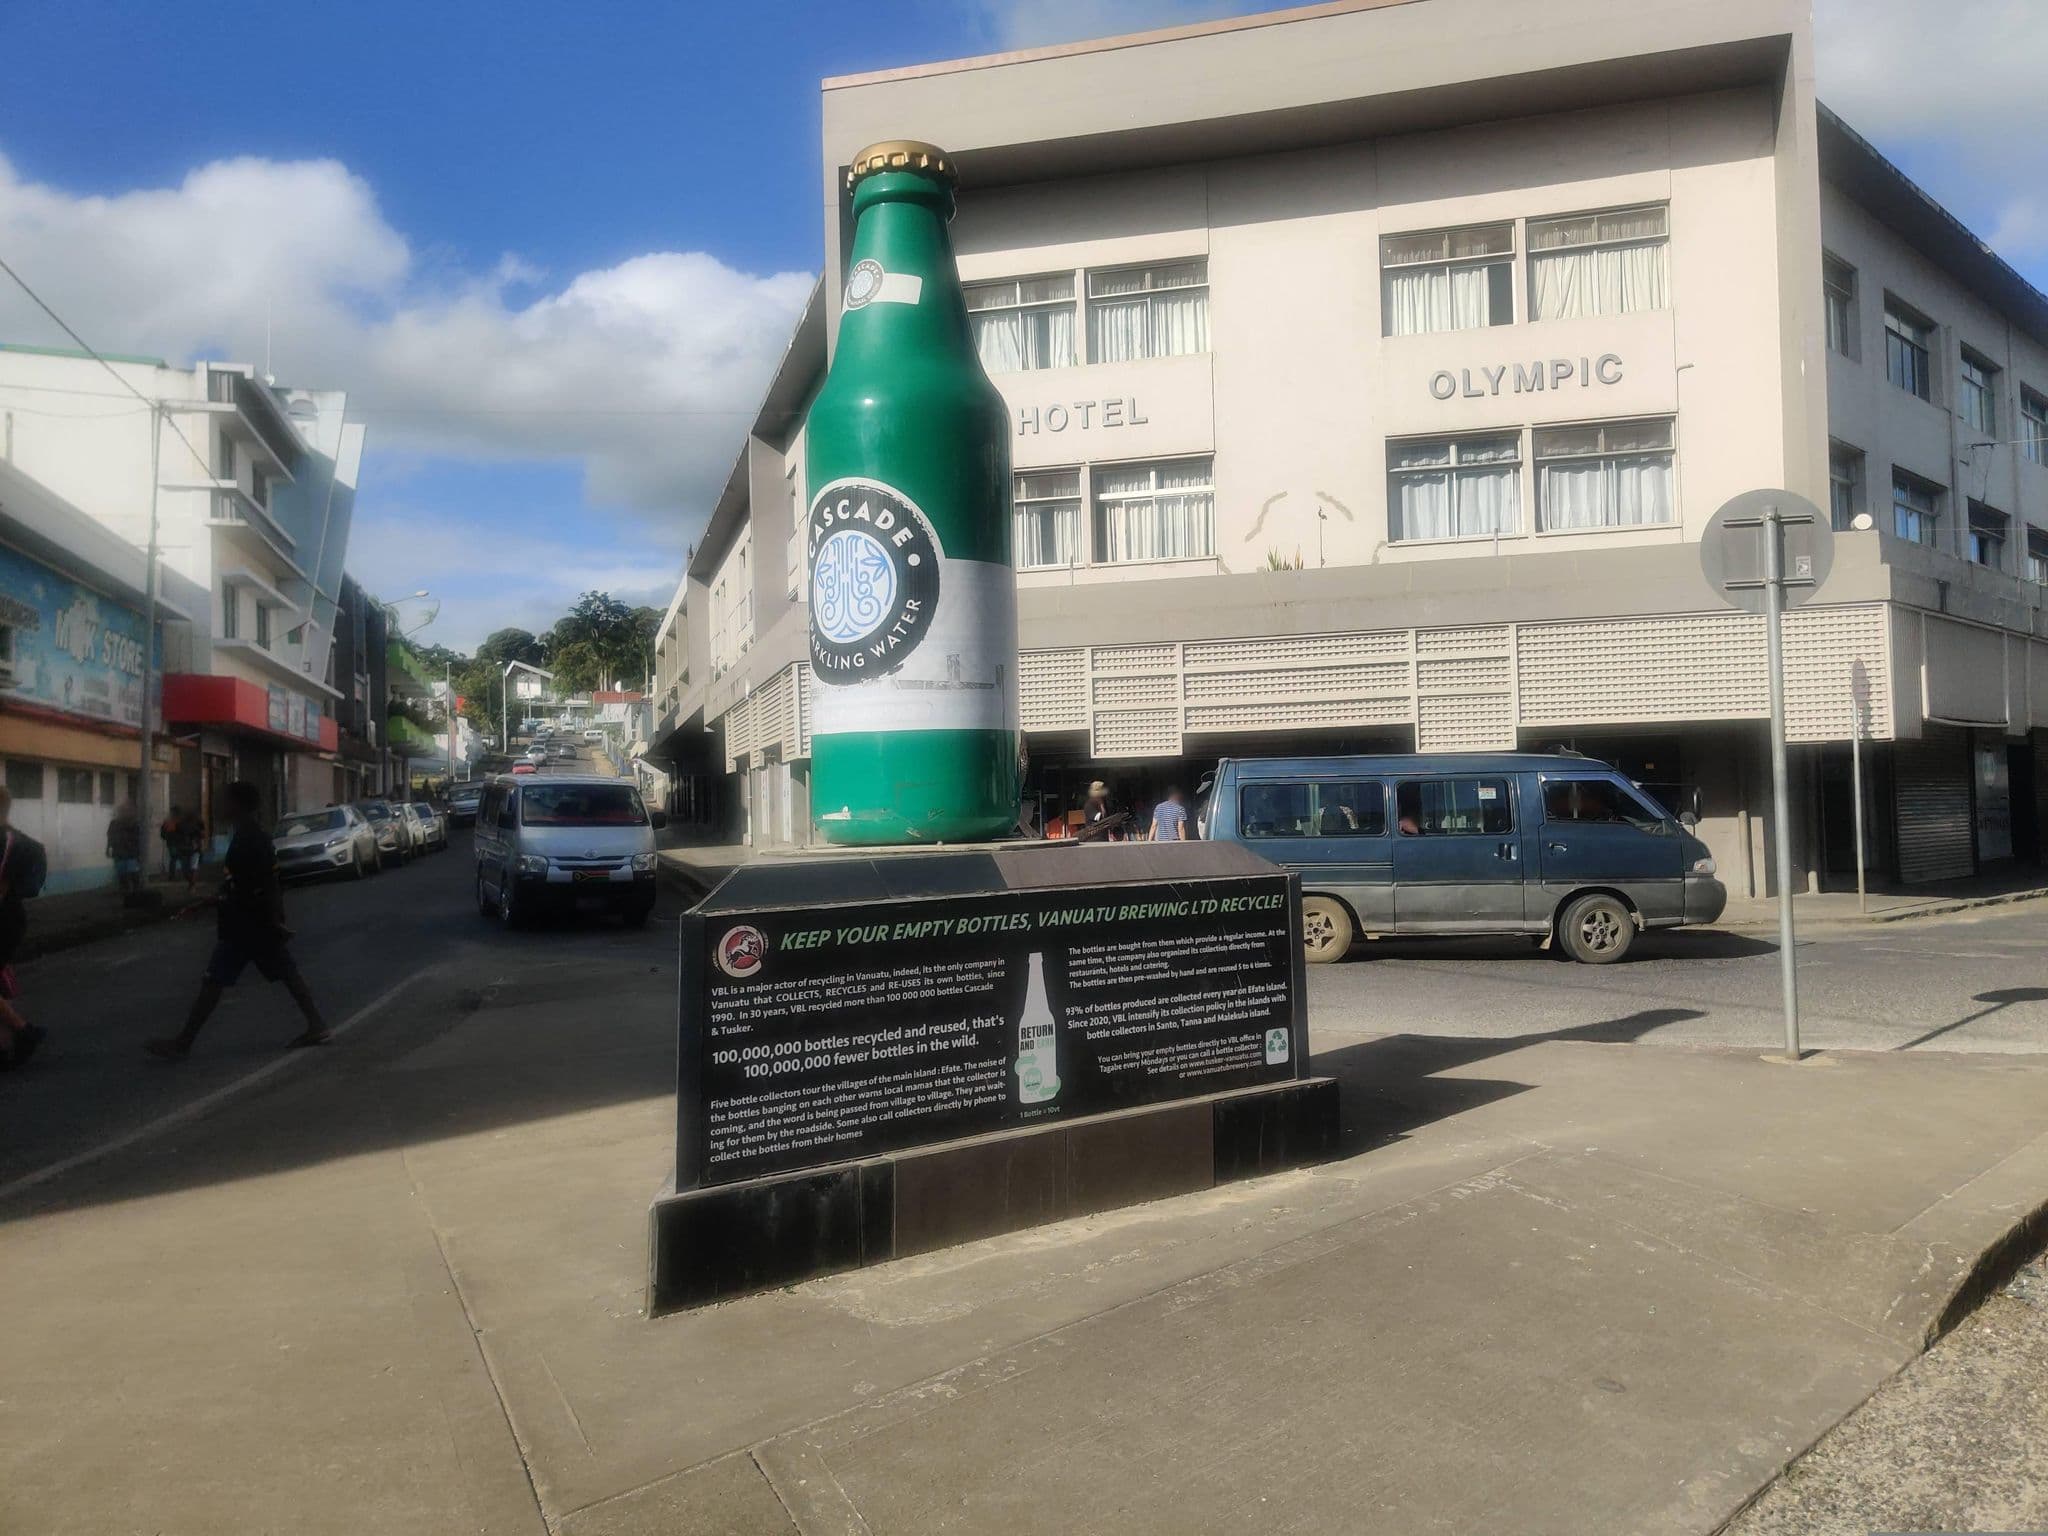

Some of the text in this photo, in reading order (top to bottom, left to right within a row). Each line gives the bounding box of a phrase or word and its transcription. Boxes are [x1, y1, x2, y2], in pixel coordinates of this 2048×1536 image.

[1018, 353, 1625, 435] HOTEL OLYMPIC
[870, 598, 922, 660] WATER
[781, 930, 831, 950] KEEP
[837, 925, 888, 945] YOUR
[892, 919, 954, 940] EMPTY
[956, 913, 1032, 934] BOTTLES,
[1039, 906, 1116, 927] VANUATU
[1118, 901, 1189, 920] BREWING
[1192, 899, 1218, 914] LTD
[1220, 894, 1284, 912] RECYCLE!
[712, 987, 729, 996] VBL
[730, 985, 737, 994] is
[746, 982, 773, 993] major
[774, 981, 796, 989] actor
[798, 978, 807, 987] of
[808, 975, 845, 986] recycling
[846, 973, 854, 981] in
[856, 971, 891, 980] Vanuatu,
[893, 966, 921, 976] indeed,
[923, 965, 932, 973] its
[933, 964, 946, 972] the
[947, 962, 963, 971] only
[964, 960, 997, 969] company
[998, 957, 1004, 965] in
[712, 970, 1005, 1009] Vanuatu that COLLECTS, RECYCLES and RE-USES its own bottles, since
[711, 982, 993, 1022] 1990. In 30 years, VBL recycled more than 100 000 000 bottles Cascade
[1065, 1006, 1083, 1016] 93%
[1094, 1002, 1121, 1012] bottles
[1122, 996, 1156, 1011] produced
[1170, 991, 1201, 1003] collected
[1202, 991, 1221, 999] every
[1222, 989, 1237, 998] year
[1248, 985, 1265, 993] Efate
[1266, 981, 1287, 991] island.
[1068, 1019, 1088, 1029] Since
[1089, 1016, 1110, 1026] 2020,
[1112, 1013, 1126, 1023] VBL
[1128, 1009, 1159, 1021] intensify
[1160, 1008, 1169, 1017] its
[1170, 1004, 1204, 1015] collection
[1206, 1001, 1226, 1013] policy
[1235, 999, 1246, 1007] the
[1247, 995, 1270, 1005] islands
[1271, 993, 1286, 1002] with
[711, 1024, 753, 1036] & Tusker.
[712, 1015, 1004, 1064] 100,000,000 bottles recycled and reused, that's
[1020, 1023, 1054, 1040] RETURN
[744, 1033, 979, 1077] 100,000,000 fewer bottles in the wild.
[710, 1100, 728, 1109] Five
[730, 1094, 757, 1106] bottle
[759, 1090, 801, 1101] collectors
[802, 1087, 820, 1095] tour
[822, 1083, 835, 1092] the
[837, 1079, 867, 1089] villages
[868, 1076, 878, 1085] of
[878, 1075, 891, 1083] the
[893, 1071, 912, 1081] main
[913, 1067, 936, 1078] island
[941, 1065, 962, 1073] Efate.
[963, 1062, 977, 1070] The
[978, 1058, 997, 1068] noise
[998, 1056, 1006, 1065] of
[710, 1113, 726, 1122] the
[728, 1108, 760, 1120] bottles
[762, 1102, 797, 1114] banging
[812, 1095, 831, 1106] each
[833, 1093, 856, 1103] other
[858, 1090, 882, 1099] warns
[884, 1084, 903, 1095] local
[905, 1081, 933, 1091] mamas
[934, 1078, 950, 1086] that
[952, 1076, 965, 1084] the
[966, 1071, 998, 1082] collector
[1000, 1068, 1006, 1076] is
[710, 1130, 862, 1162] collect the bottles from their homes
